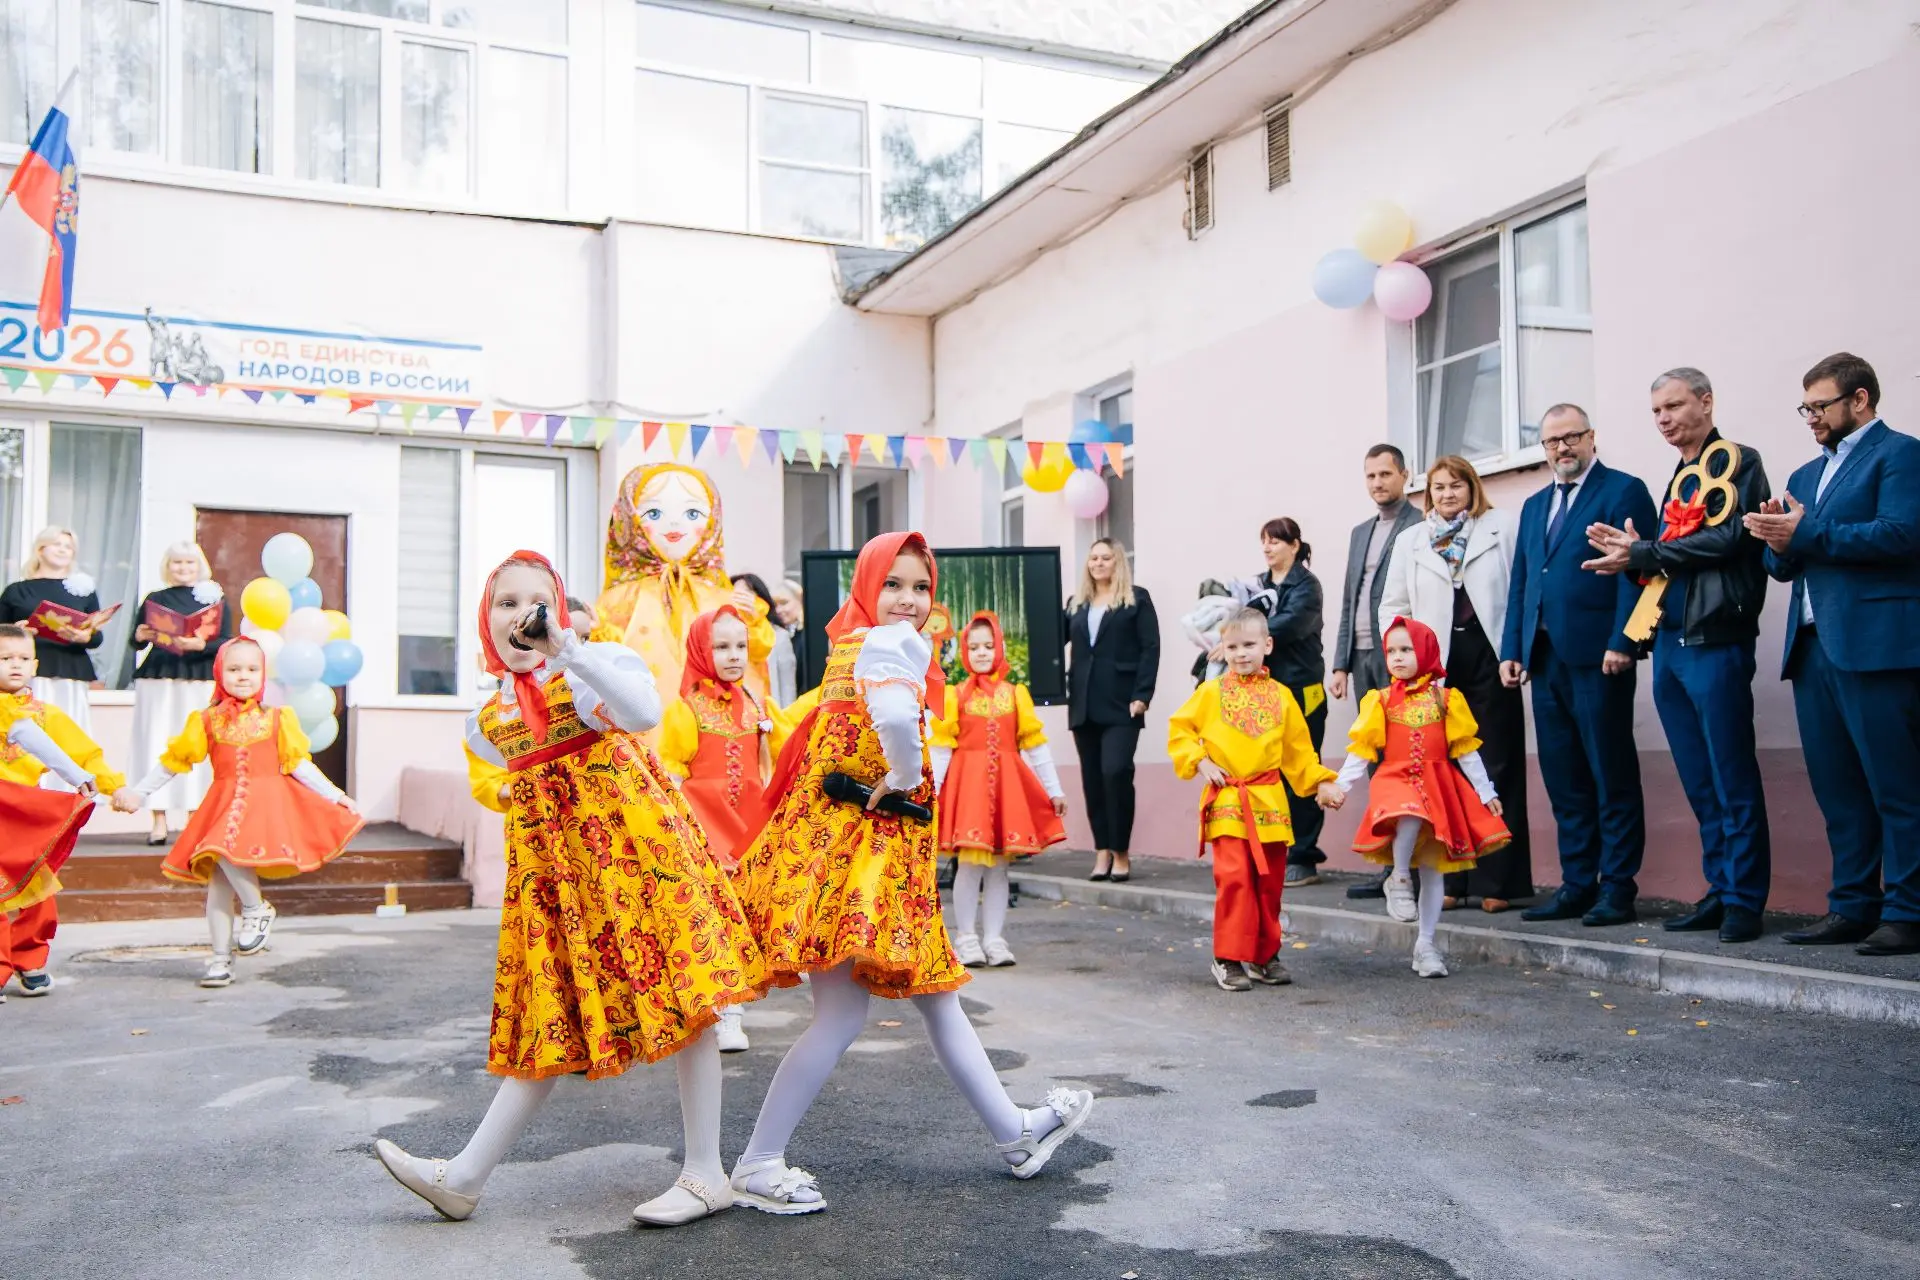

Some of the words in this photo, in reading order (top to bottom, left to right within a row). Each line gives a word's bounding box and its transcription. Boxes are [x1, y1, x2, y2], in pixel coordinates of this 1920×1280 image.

[0, 317, 134, 368] 2026
[239, 338, 289, 360] ГОД
[300, 344, 430, 369] ЕДИНСТВА
[239, 360, 360, 385] НАРОДОВ
[369, 371, 470, 393] РОССИИ
